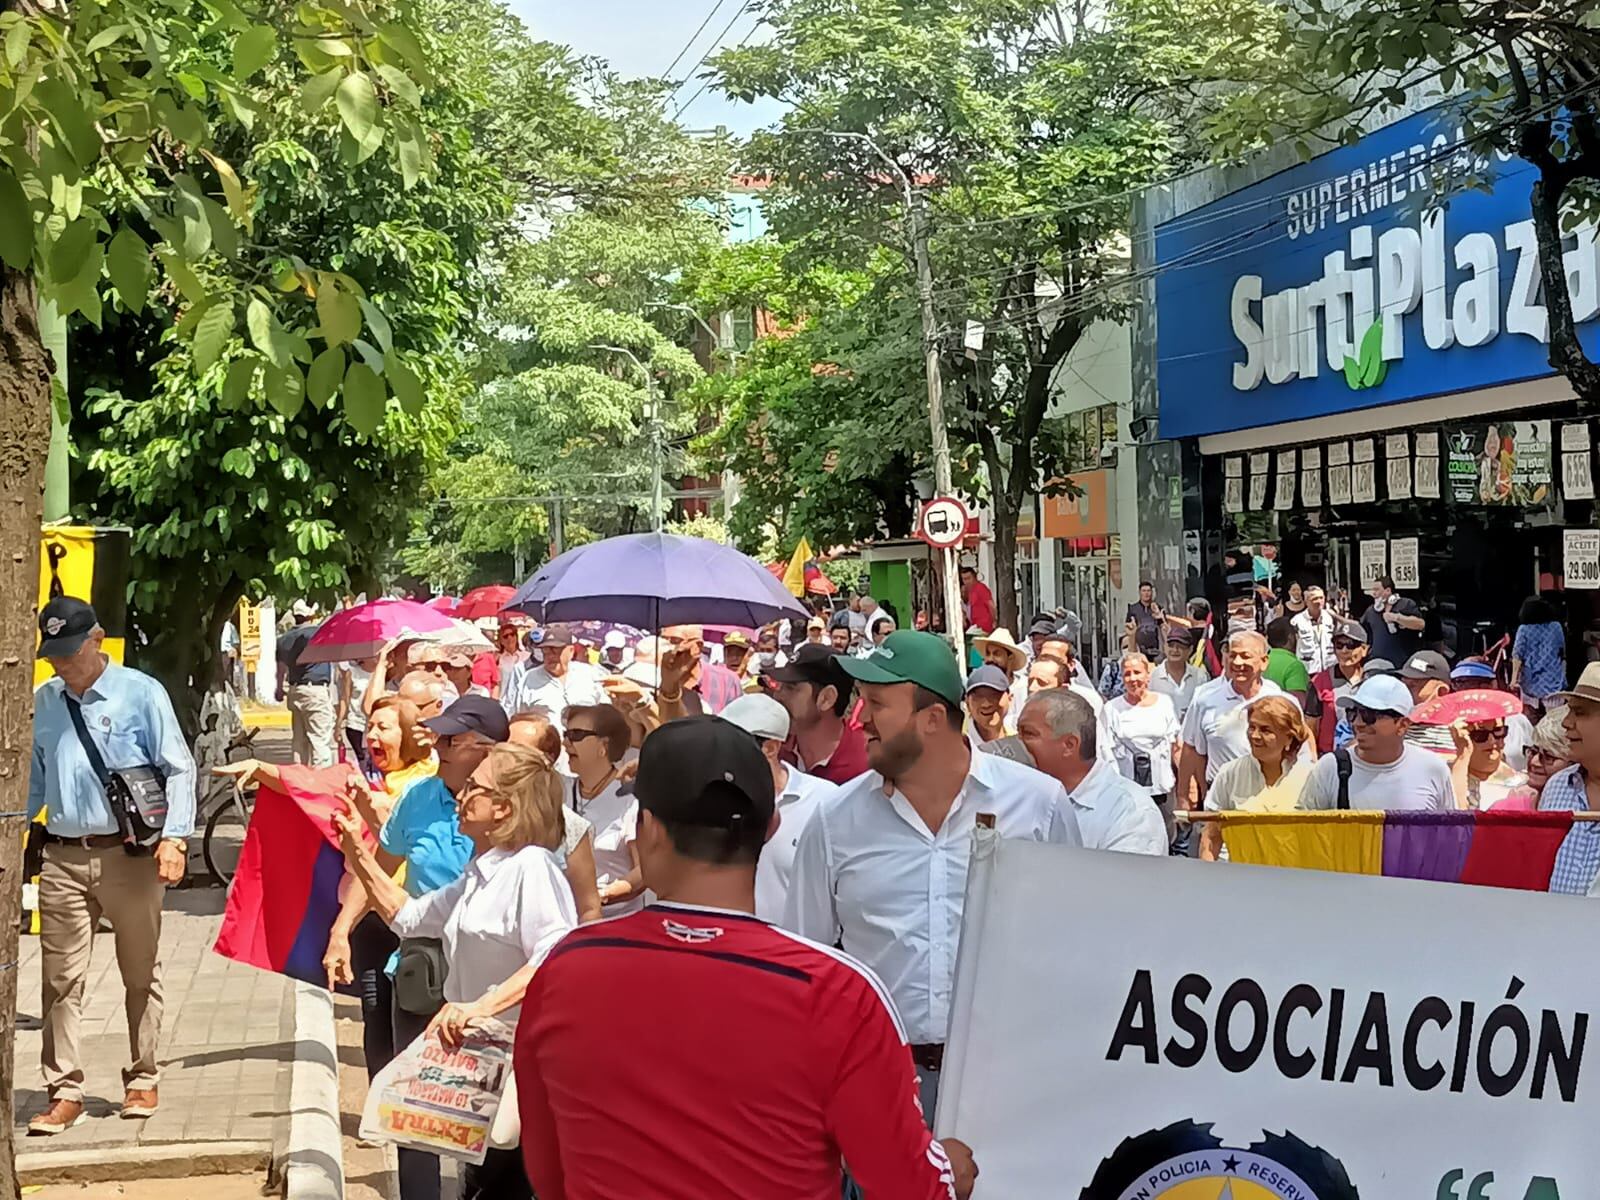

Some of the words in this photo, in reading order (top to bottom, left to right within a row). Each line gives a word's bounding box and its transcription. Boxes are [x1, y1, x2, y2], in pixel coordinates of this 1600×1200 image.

[1105, 968, 1589, 1103] ASOCIACIÓN
[391, 1110, 471, 1146] EXTRA
[1148, 1159, 1212, 1189] POLICIA
